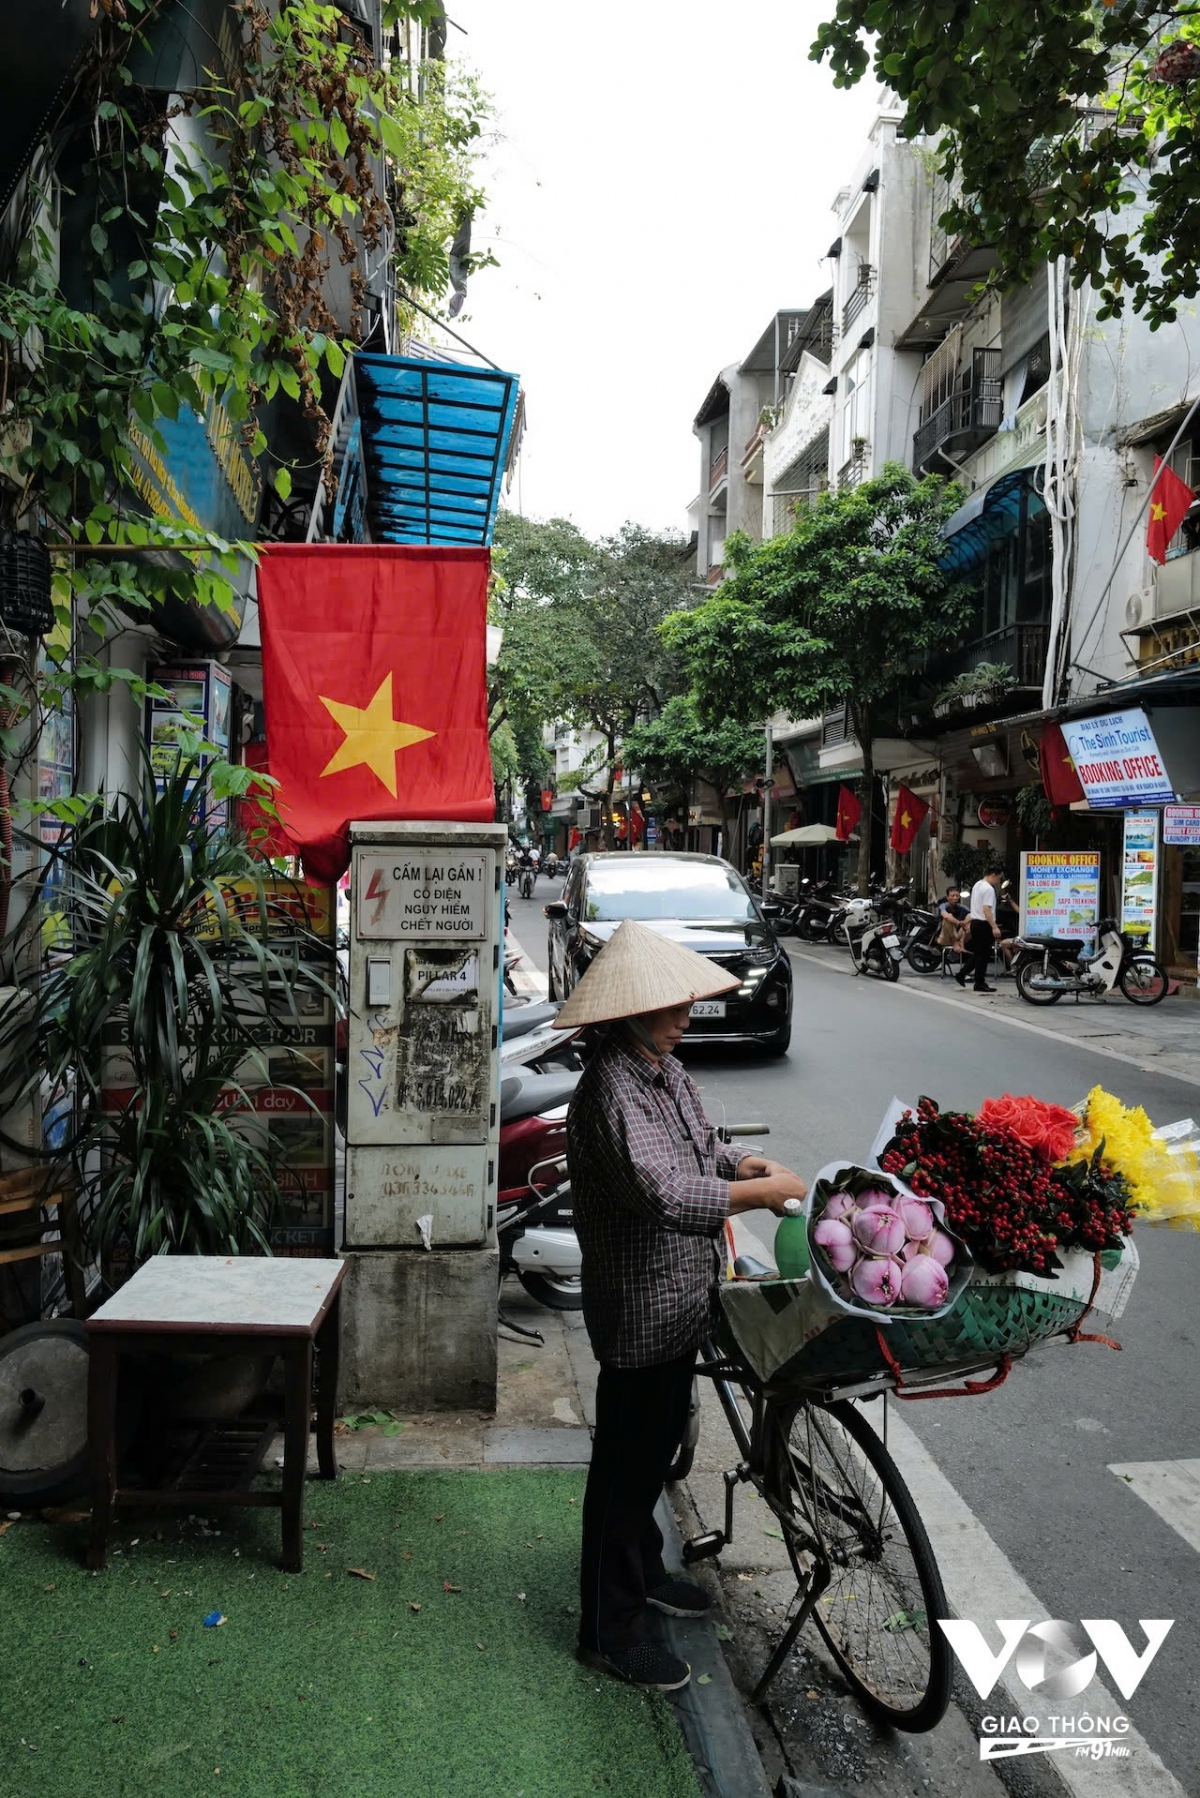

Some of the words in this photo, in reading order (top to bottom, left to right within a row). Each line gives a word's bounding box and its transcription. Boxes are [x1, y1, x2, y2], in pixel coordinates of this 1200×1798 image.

[1078, 736, 1097, 751] The
[1095, 731, 1117, 749] Sinh
[1114, 726, 1151, 746] Tourist
[1078, 760, 1124, 784] BOOKING
[1122, 754, 1163, 780] OFFICE
[1167, 808, 1194, 817] BOOKING
[1028, 854, 1067, 865] BOOKING
[1069, 854, 1098, 866] OFFICE
[393, 862, 420, 881] CẤM
[425, 867, 444, 884] LẠI
[447, 862, 474, 881] GẦN
[1056, 866, 1095, 874] EXCHANGE
[434, 887, 461, 902] ĐIỆN
[404, 905, 438, 914] NGUY
[441, 900, 470, 915] HIỂM
[400, 917, 433, 931] CHẾT
[435, 918, 474, 931] NGƯỜI
[418, 971, 457, 981] PILLAR
[459, 971, 467, 981] 4
[264, 1093, 296, 1110] day
